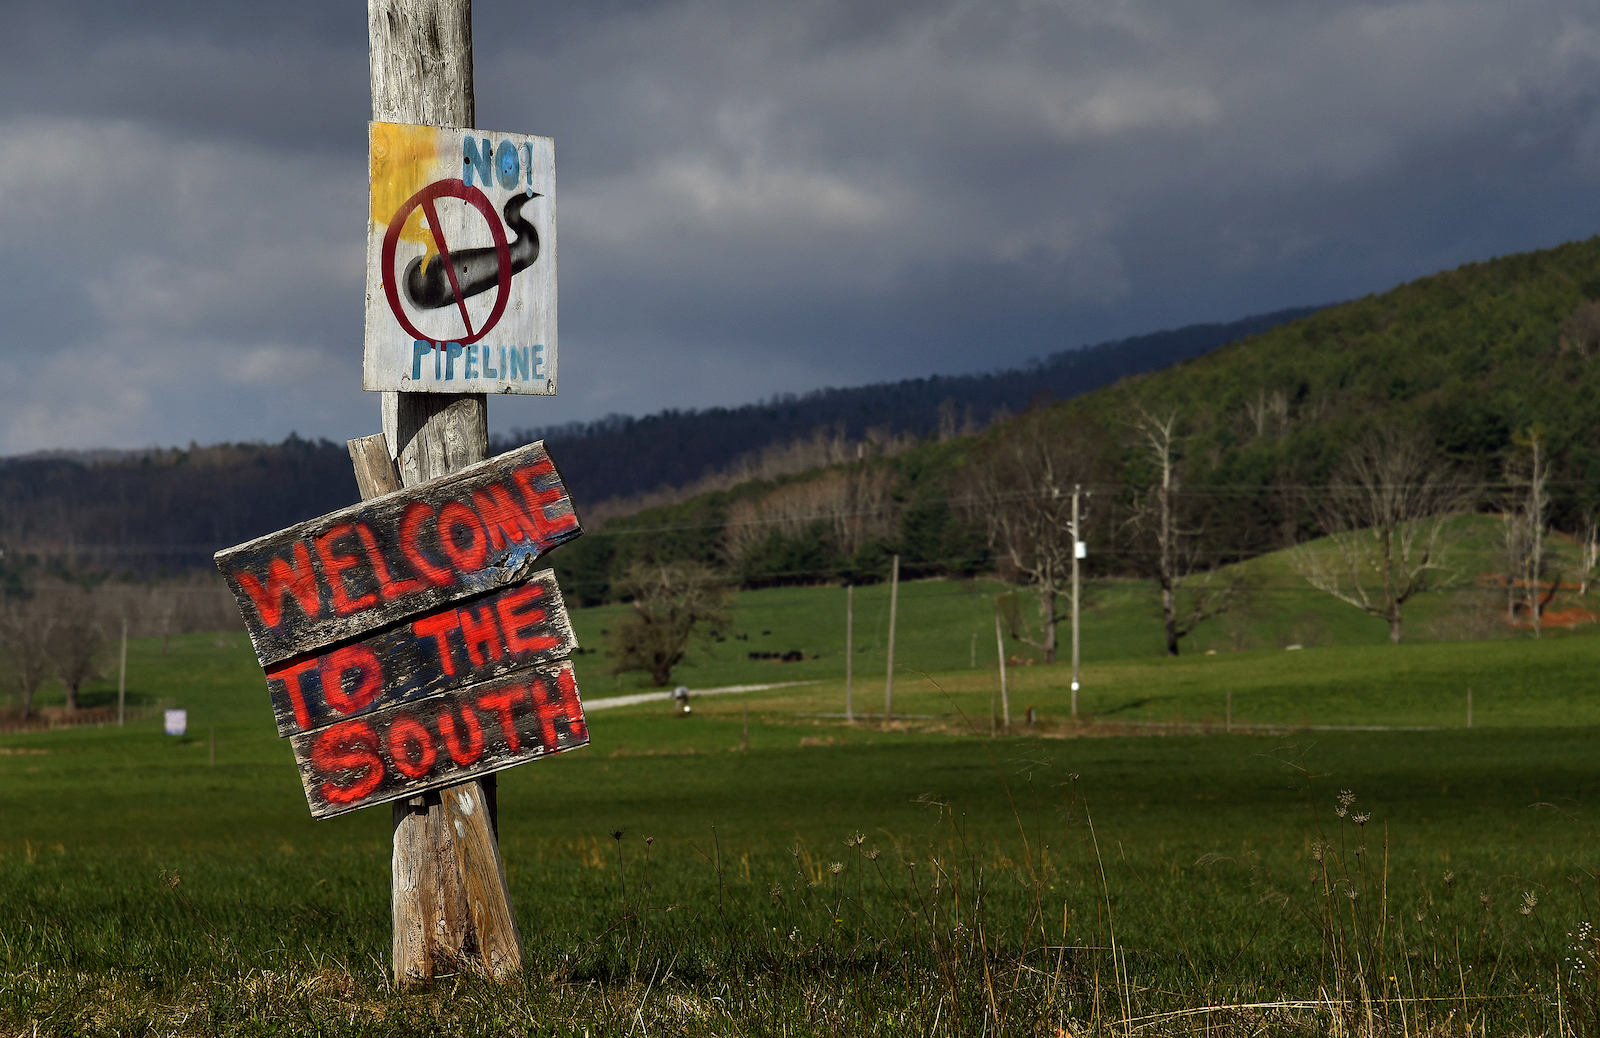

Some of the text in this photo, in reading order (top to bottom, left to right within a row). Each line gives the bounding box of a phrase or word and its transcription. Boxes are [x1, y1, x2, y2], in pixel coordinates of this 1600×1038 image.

[463, 135, 533, 198] NO!
[412, 339, 545, 381] PIPELINE
[234, 457, 578, 628] WELCOME
[265, 583, 563, 731] TO THE
[311, 668, 586, 804] SOUTH
